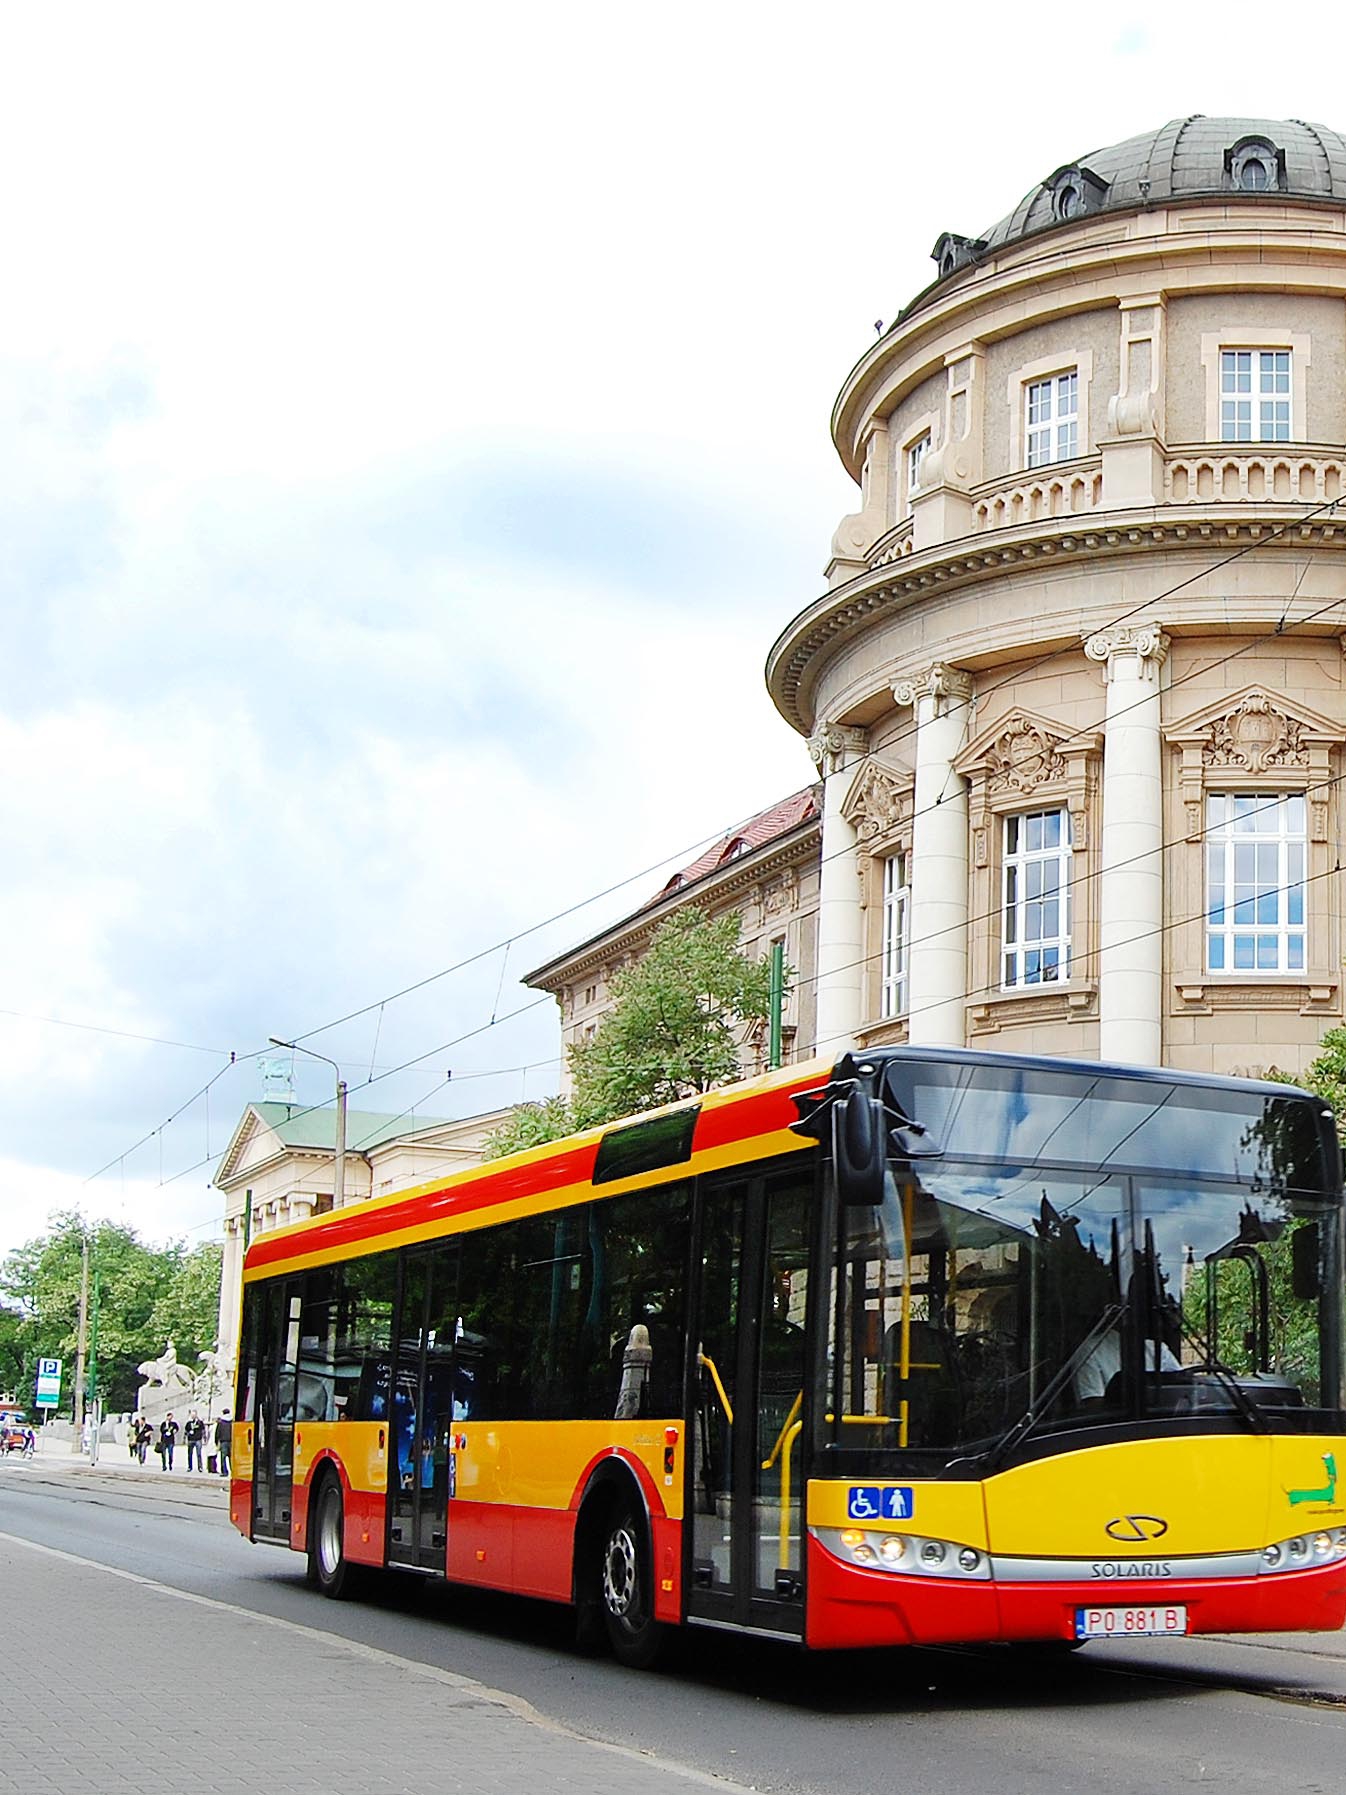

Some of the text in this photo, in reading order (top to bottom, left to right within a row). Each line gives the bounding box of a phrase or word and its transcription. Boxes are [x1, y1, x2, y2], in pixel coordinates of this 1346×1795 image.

[1090, 1563, 1172, 1578] SOLARIS
[1124, 1610, 1156, 1630] 881
[1165, 1609, 1178, 1629] B
